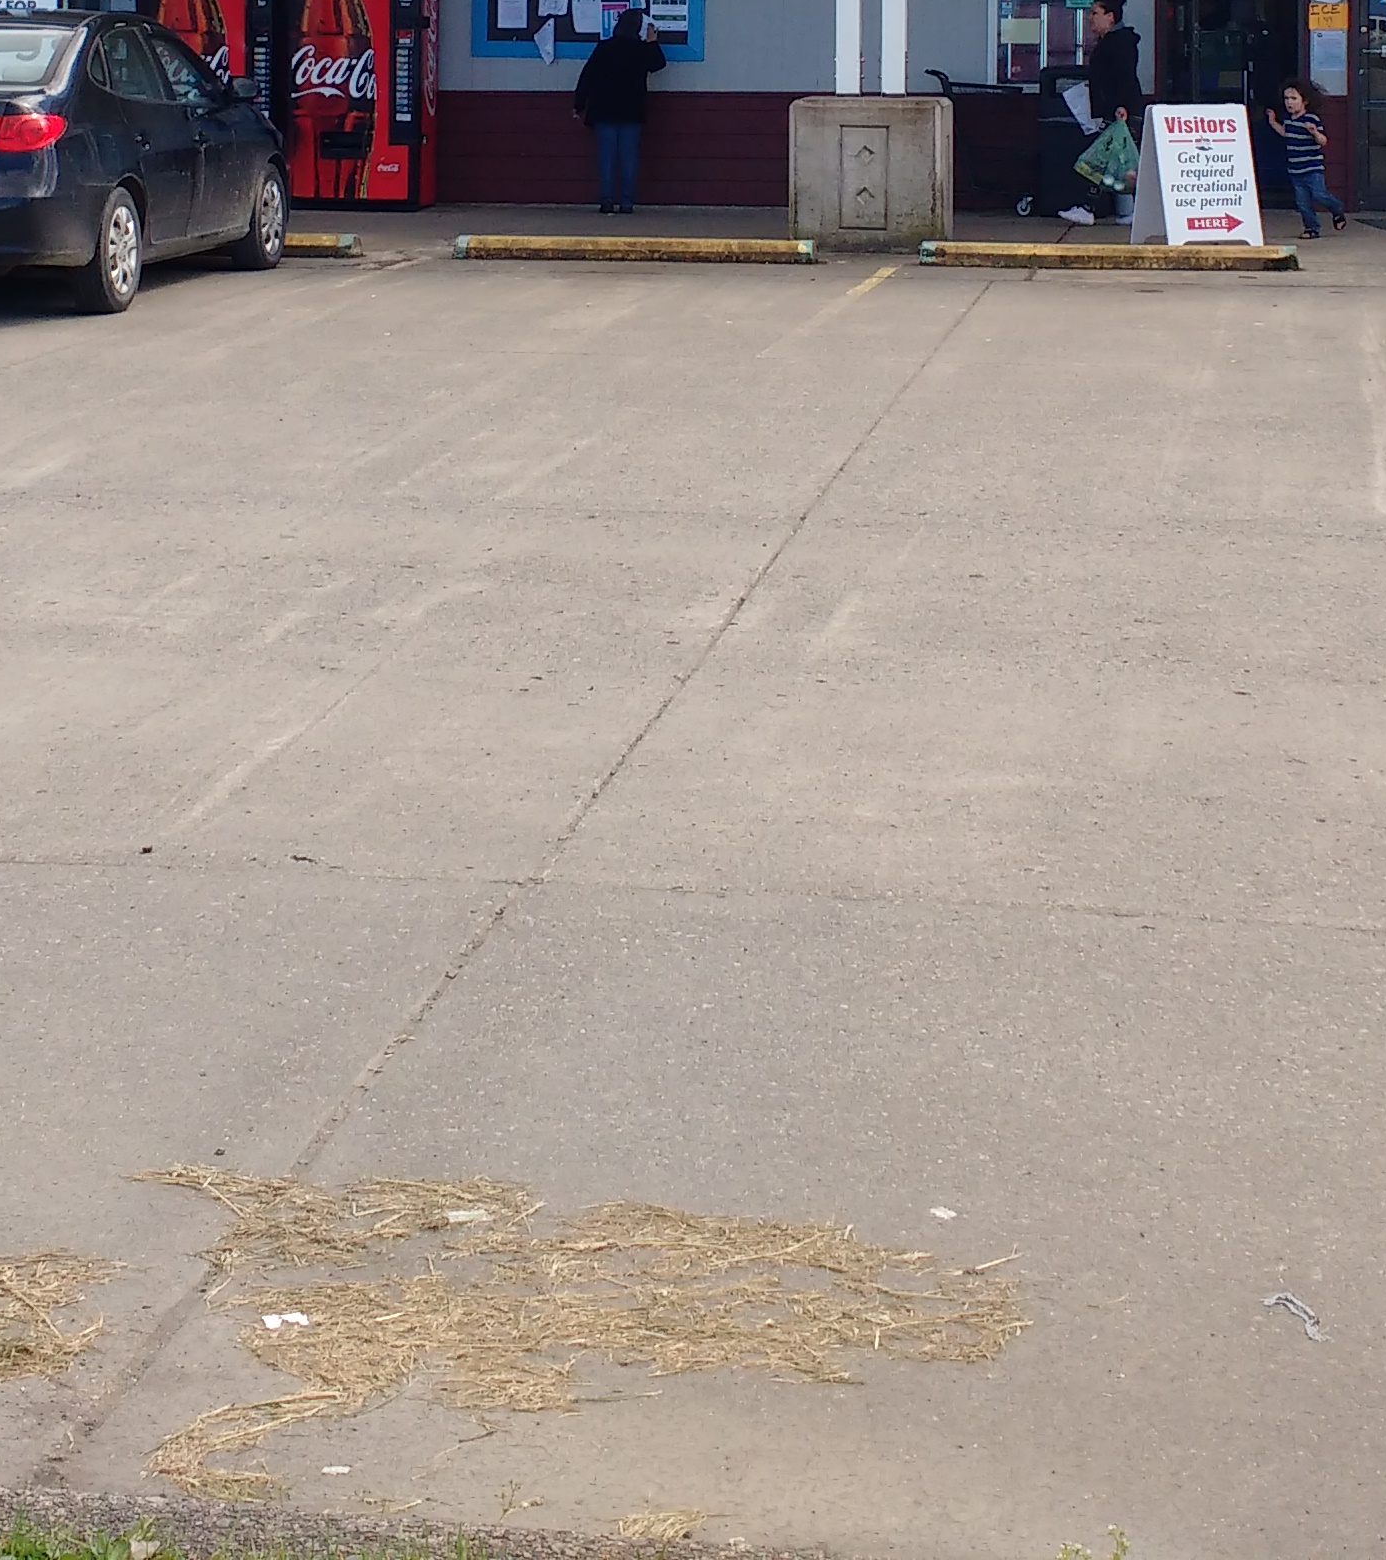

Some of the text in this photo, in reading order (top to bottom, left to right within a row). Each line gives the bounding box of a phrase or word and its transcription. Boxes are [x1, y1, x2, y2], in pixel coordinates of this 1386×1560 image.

[1310, 4, 1341, 15] ICE
[1163, 116, 1237, 134] Visitors
[1177, 151, 1234, 166] Get your
[1180, 165, 1234, 181] required
[1170, 179, 1248, 192] recreational
[1175, 194, 1242, 210] use permit
[1194, 219, 1229, 227] HERE
